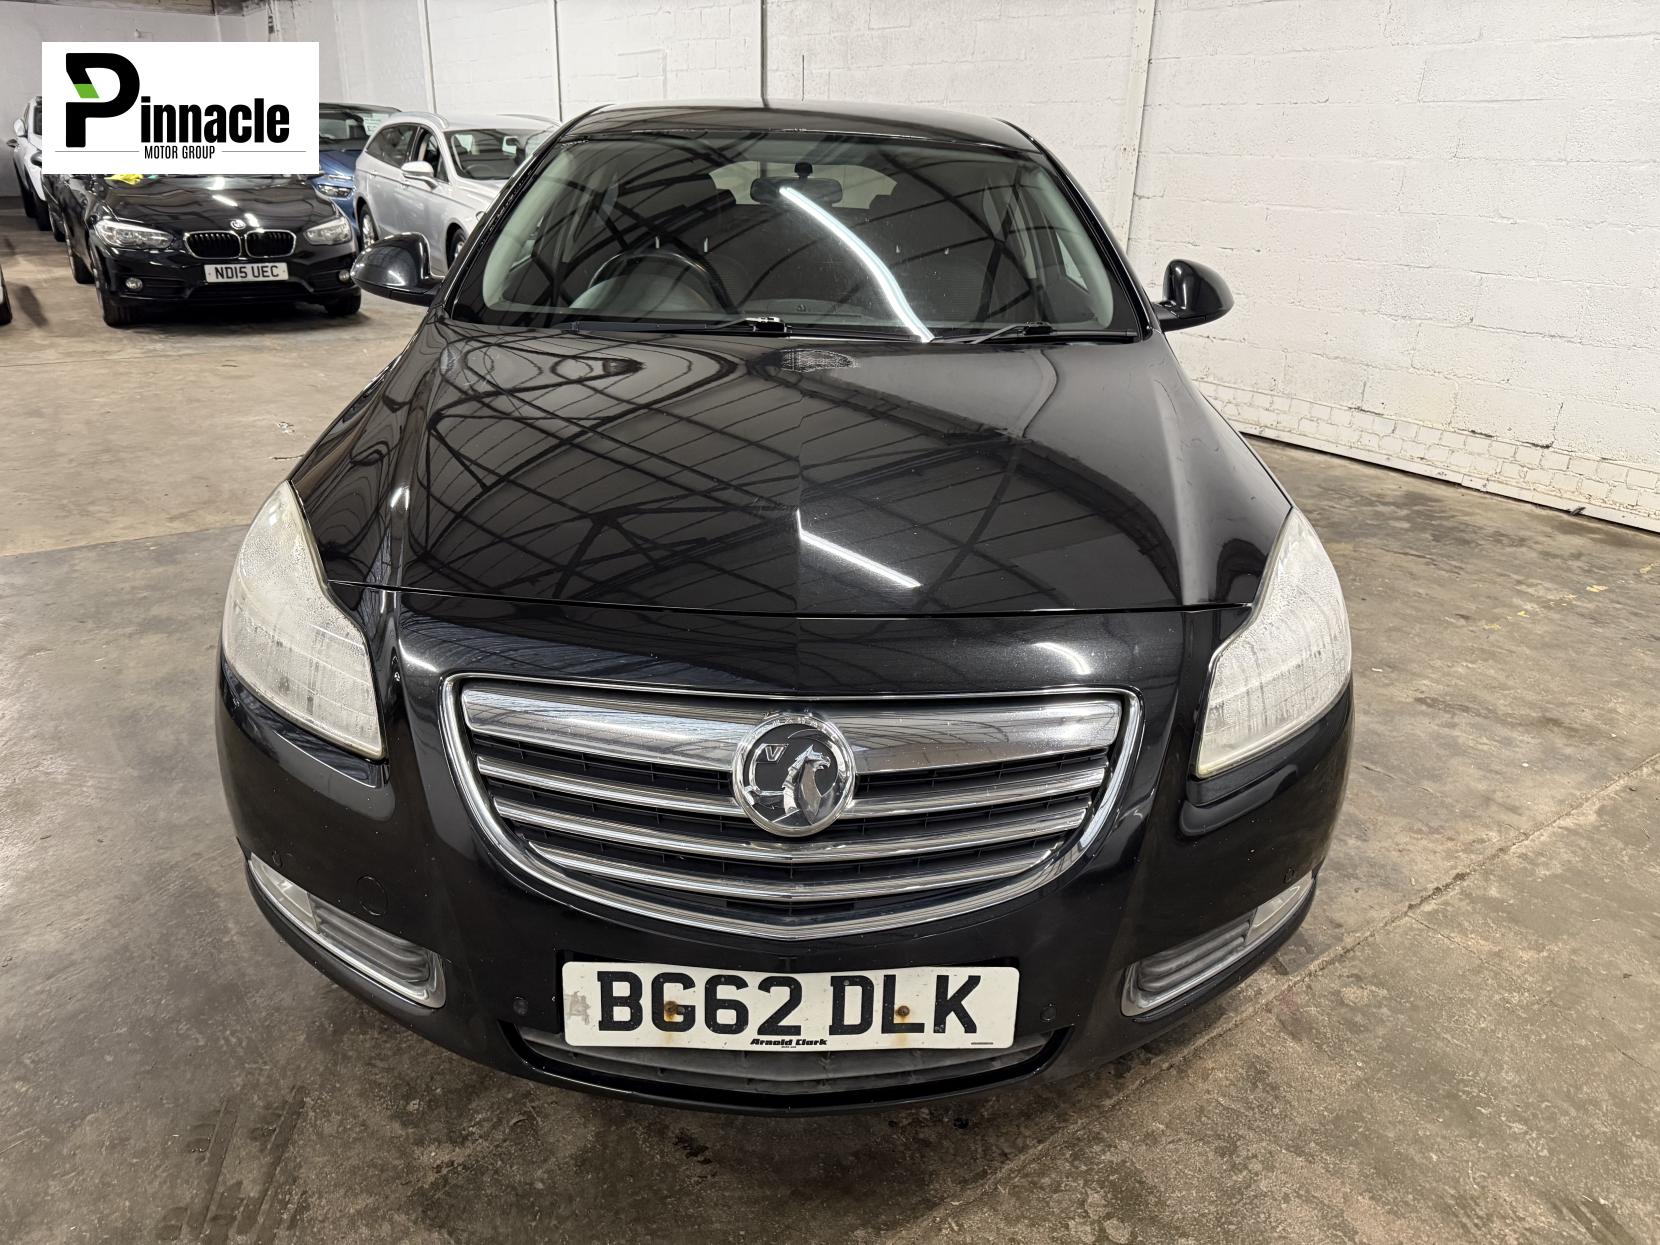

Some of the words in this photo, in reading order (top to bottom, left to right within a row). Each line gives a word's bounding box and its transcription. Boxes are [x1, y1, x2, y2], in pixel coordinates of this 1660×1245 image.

[214, 266, 248, 279] ND15
[251, 265, 279, 278] UEC
[597, 970, 803, 1036] BG62
[828, 974, 982, 1034] DLK
[750, 1038, 793, 1046] Arnold
[795, 1038, 828, 1046] Clark
